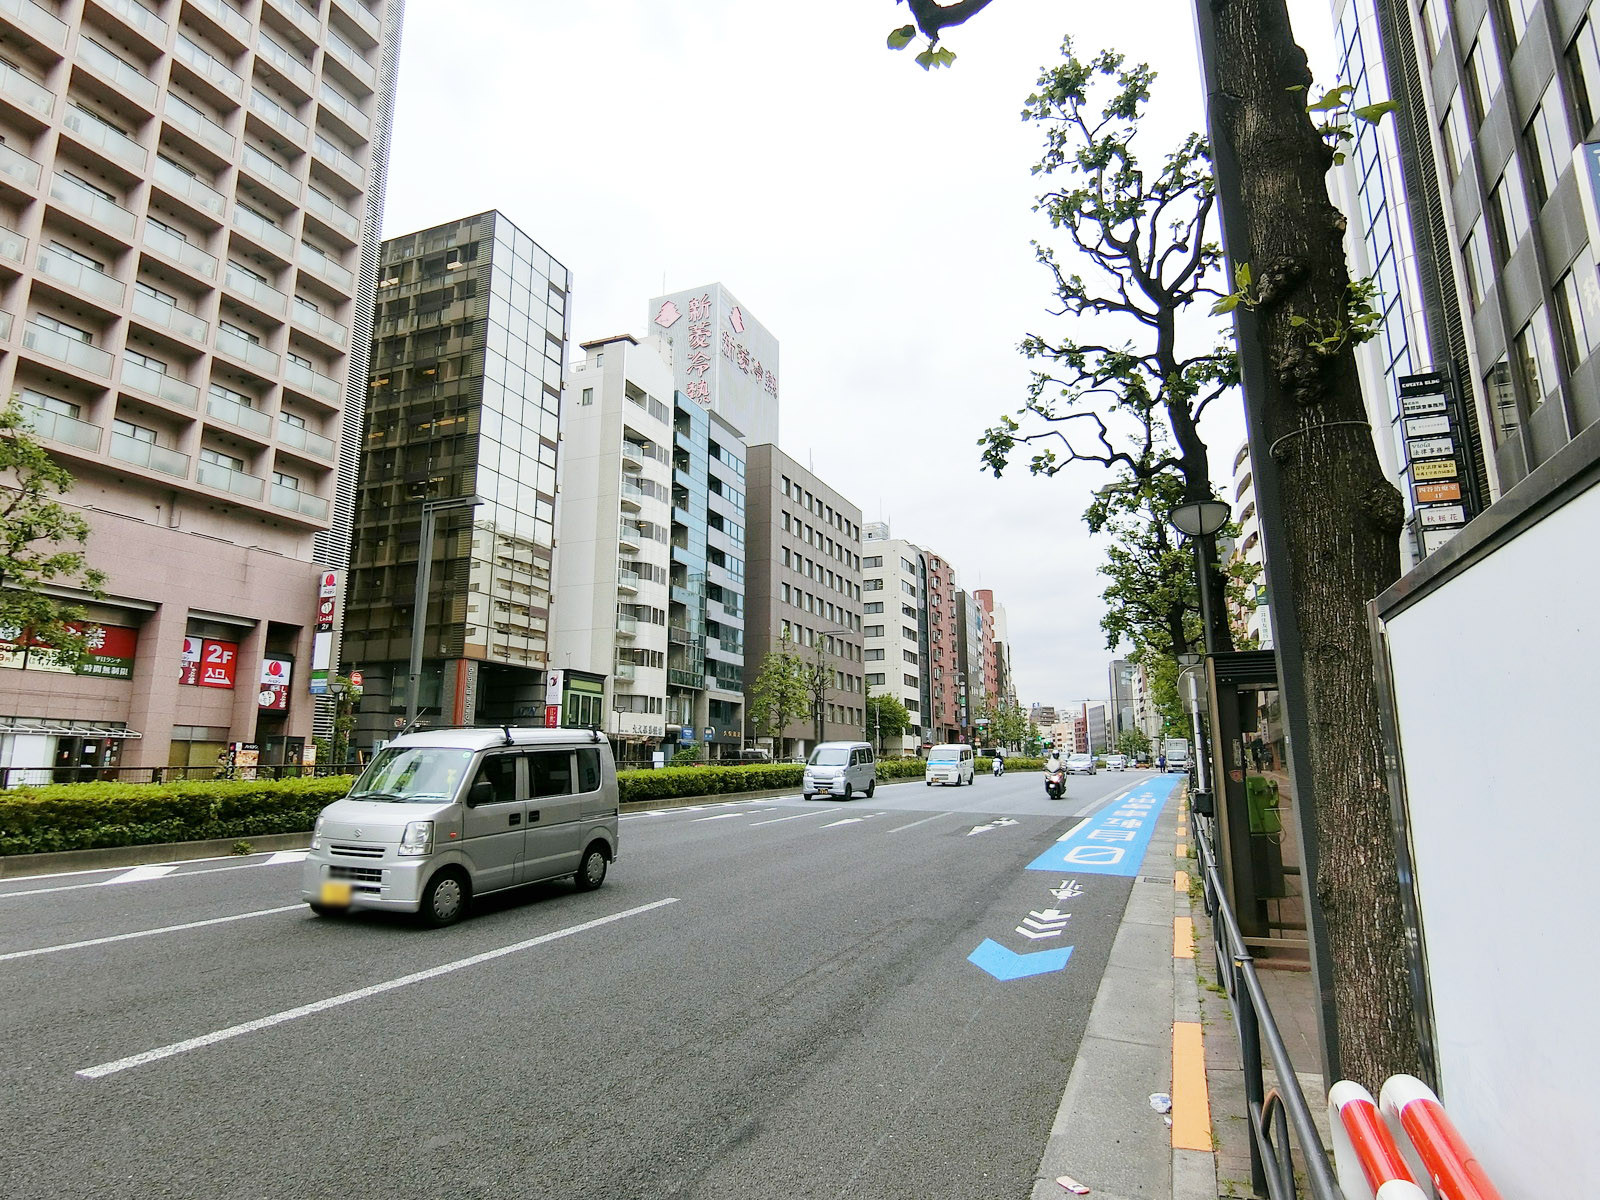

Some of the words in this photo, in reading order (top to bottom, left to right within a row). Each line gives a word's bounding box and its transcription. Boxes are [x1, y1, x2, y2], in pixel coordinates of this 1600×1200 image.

[206, 644, 233, 664] 2F
[83, 664, 129, 676] 時間無制限
[205, 667, 225, 678] 入口
